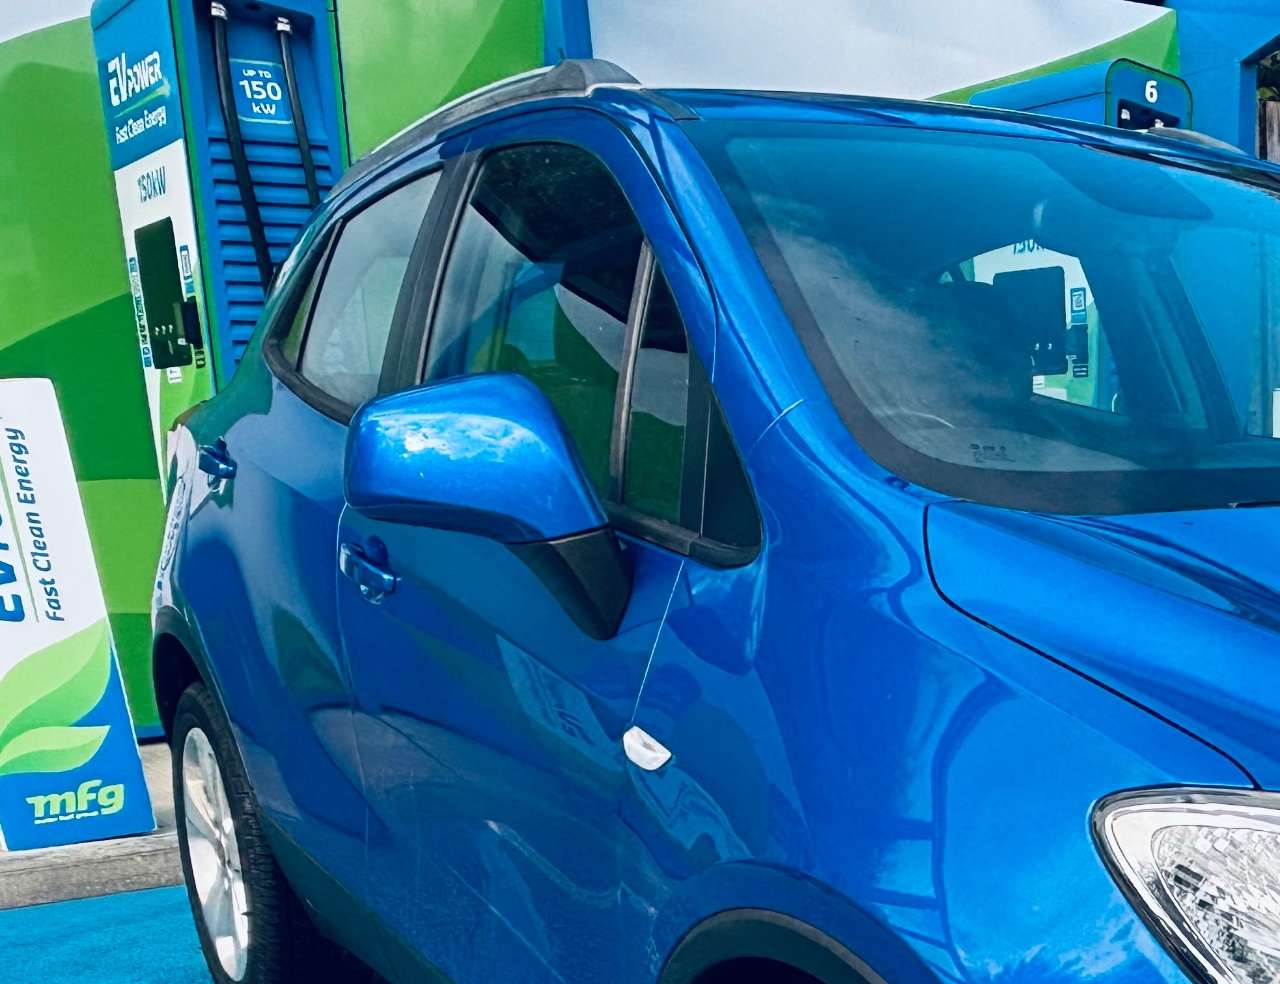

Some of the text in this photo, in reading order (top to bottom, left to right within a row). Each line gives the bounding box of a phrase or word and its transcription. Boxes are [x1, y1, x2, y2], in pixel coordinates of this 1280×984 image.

[242, 69, 272, 79] UP TO
[239, 79, 282, 100] 150
[1145, 80, 1158, 103] 6
[251, 102, 276, 115] kW
[5, 427, 65, 622] Fast Clean Energy
[25, 779, 125, 815] mfg
